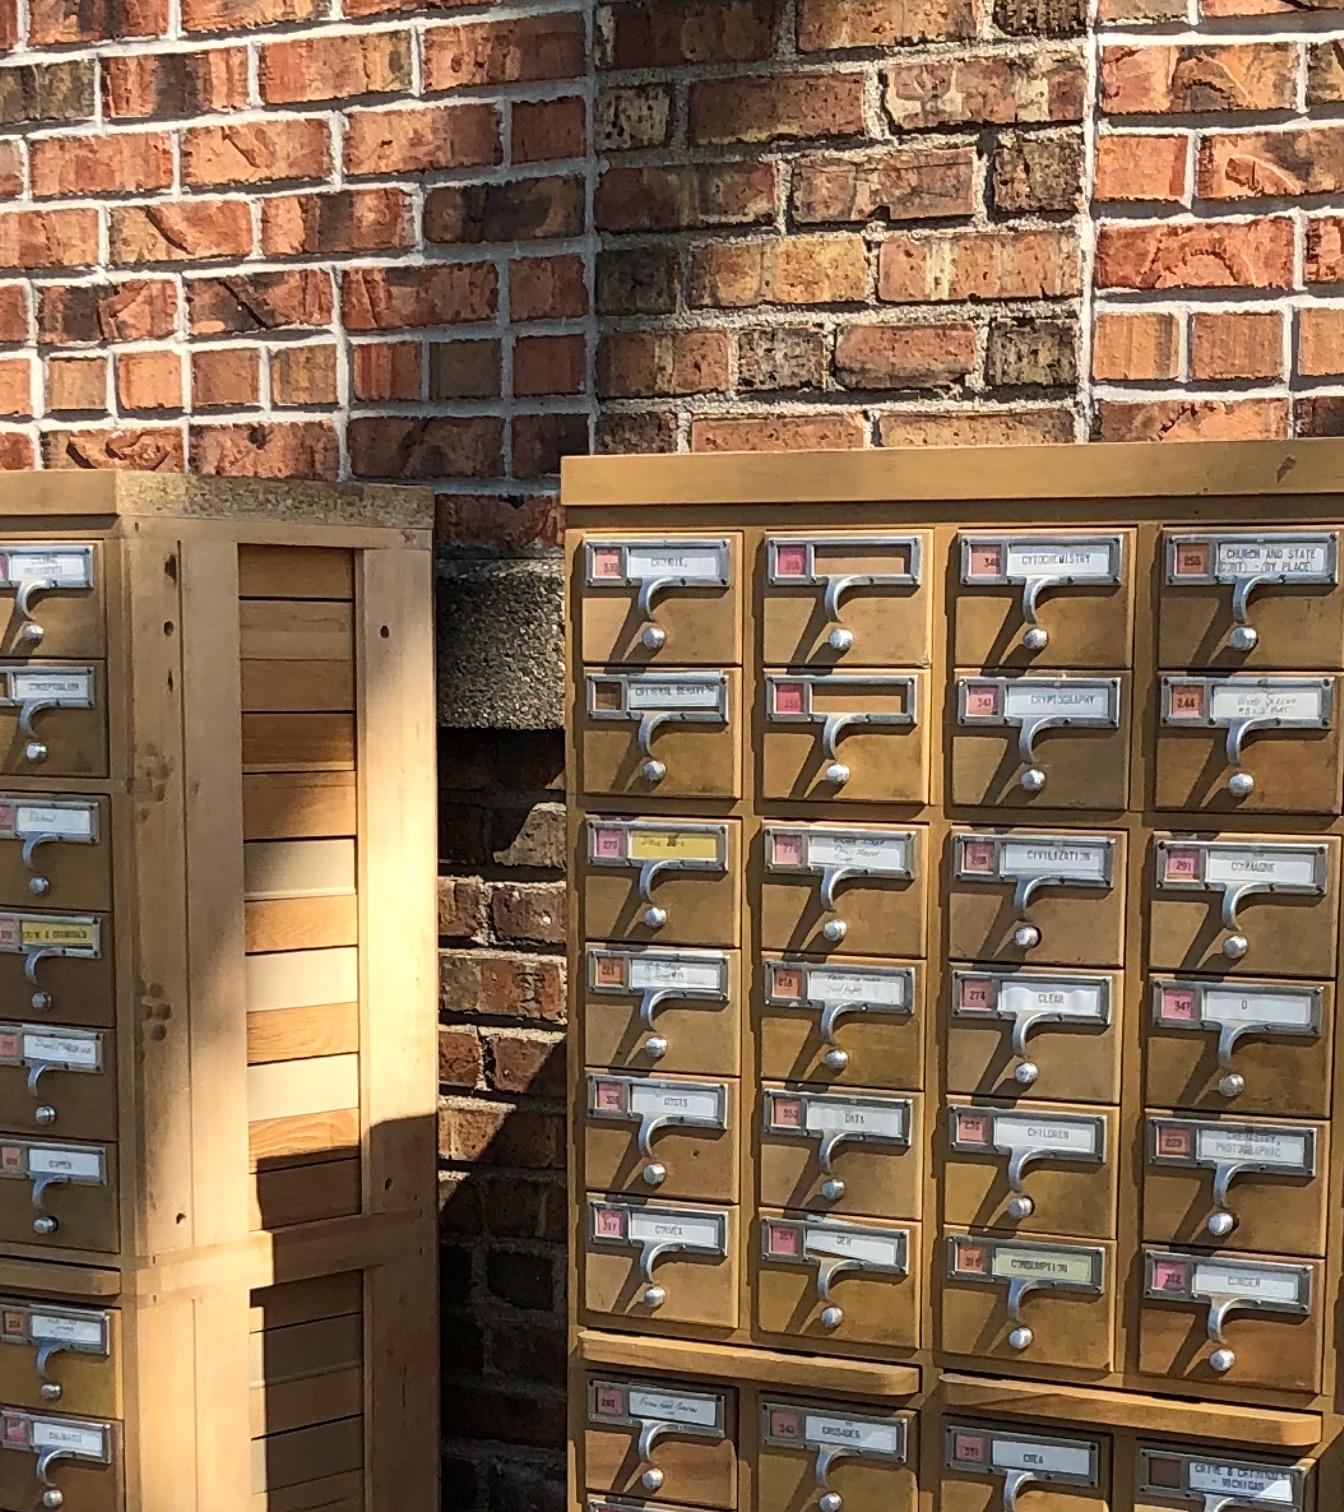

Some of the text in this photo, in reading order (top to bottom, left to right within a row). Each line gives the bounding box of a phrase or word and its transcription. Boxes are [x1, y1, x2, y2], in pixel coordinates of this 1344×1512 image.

[1226, 548, 1316, 559] CHURCH AND STATE
[1022, 555, 1091, 564] CYTOCHEMISTRY
[1031, 695, 1095, 705] CRYPTOGRAPHY
[1177, 698, 1195, 707] 244
[1176, 861, 1192, 870] 291
[1038, 993, 1064, 1004] CLEAR
[1175, 1001, 1191, 1010] 347
[1242, 1001, 1247, 1010] D
[1027, 1128, 1069, 1139] CHILDREN
[655, 1225, 683, 1235] CONVEX
[1011, 1259, 1068, 1273] CONSUMPTION
[822, 1427, 861, 1439] CRUSADES
[1222, 1479, 1264, 1490] MICHIGAN
